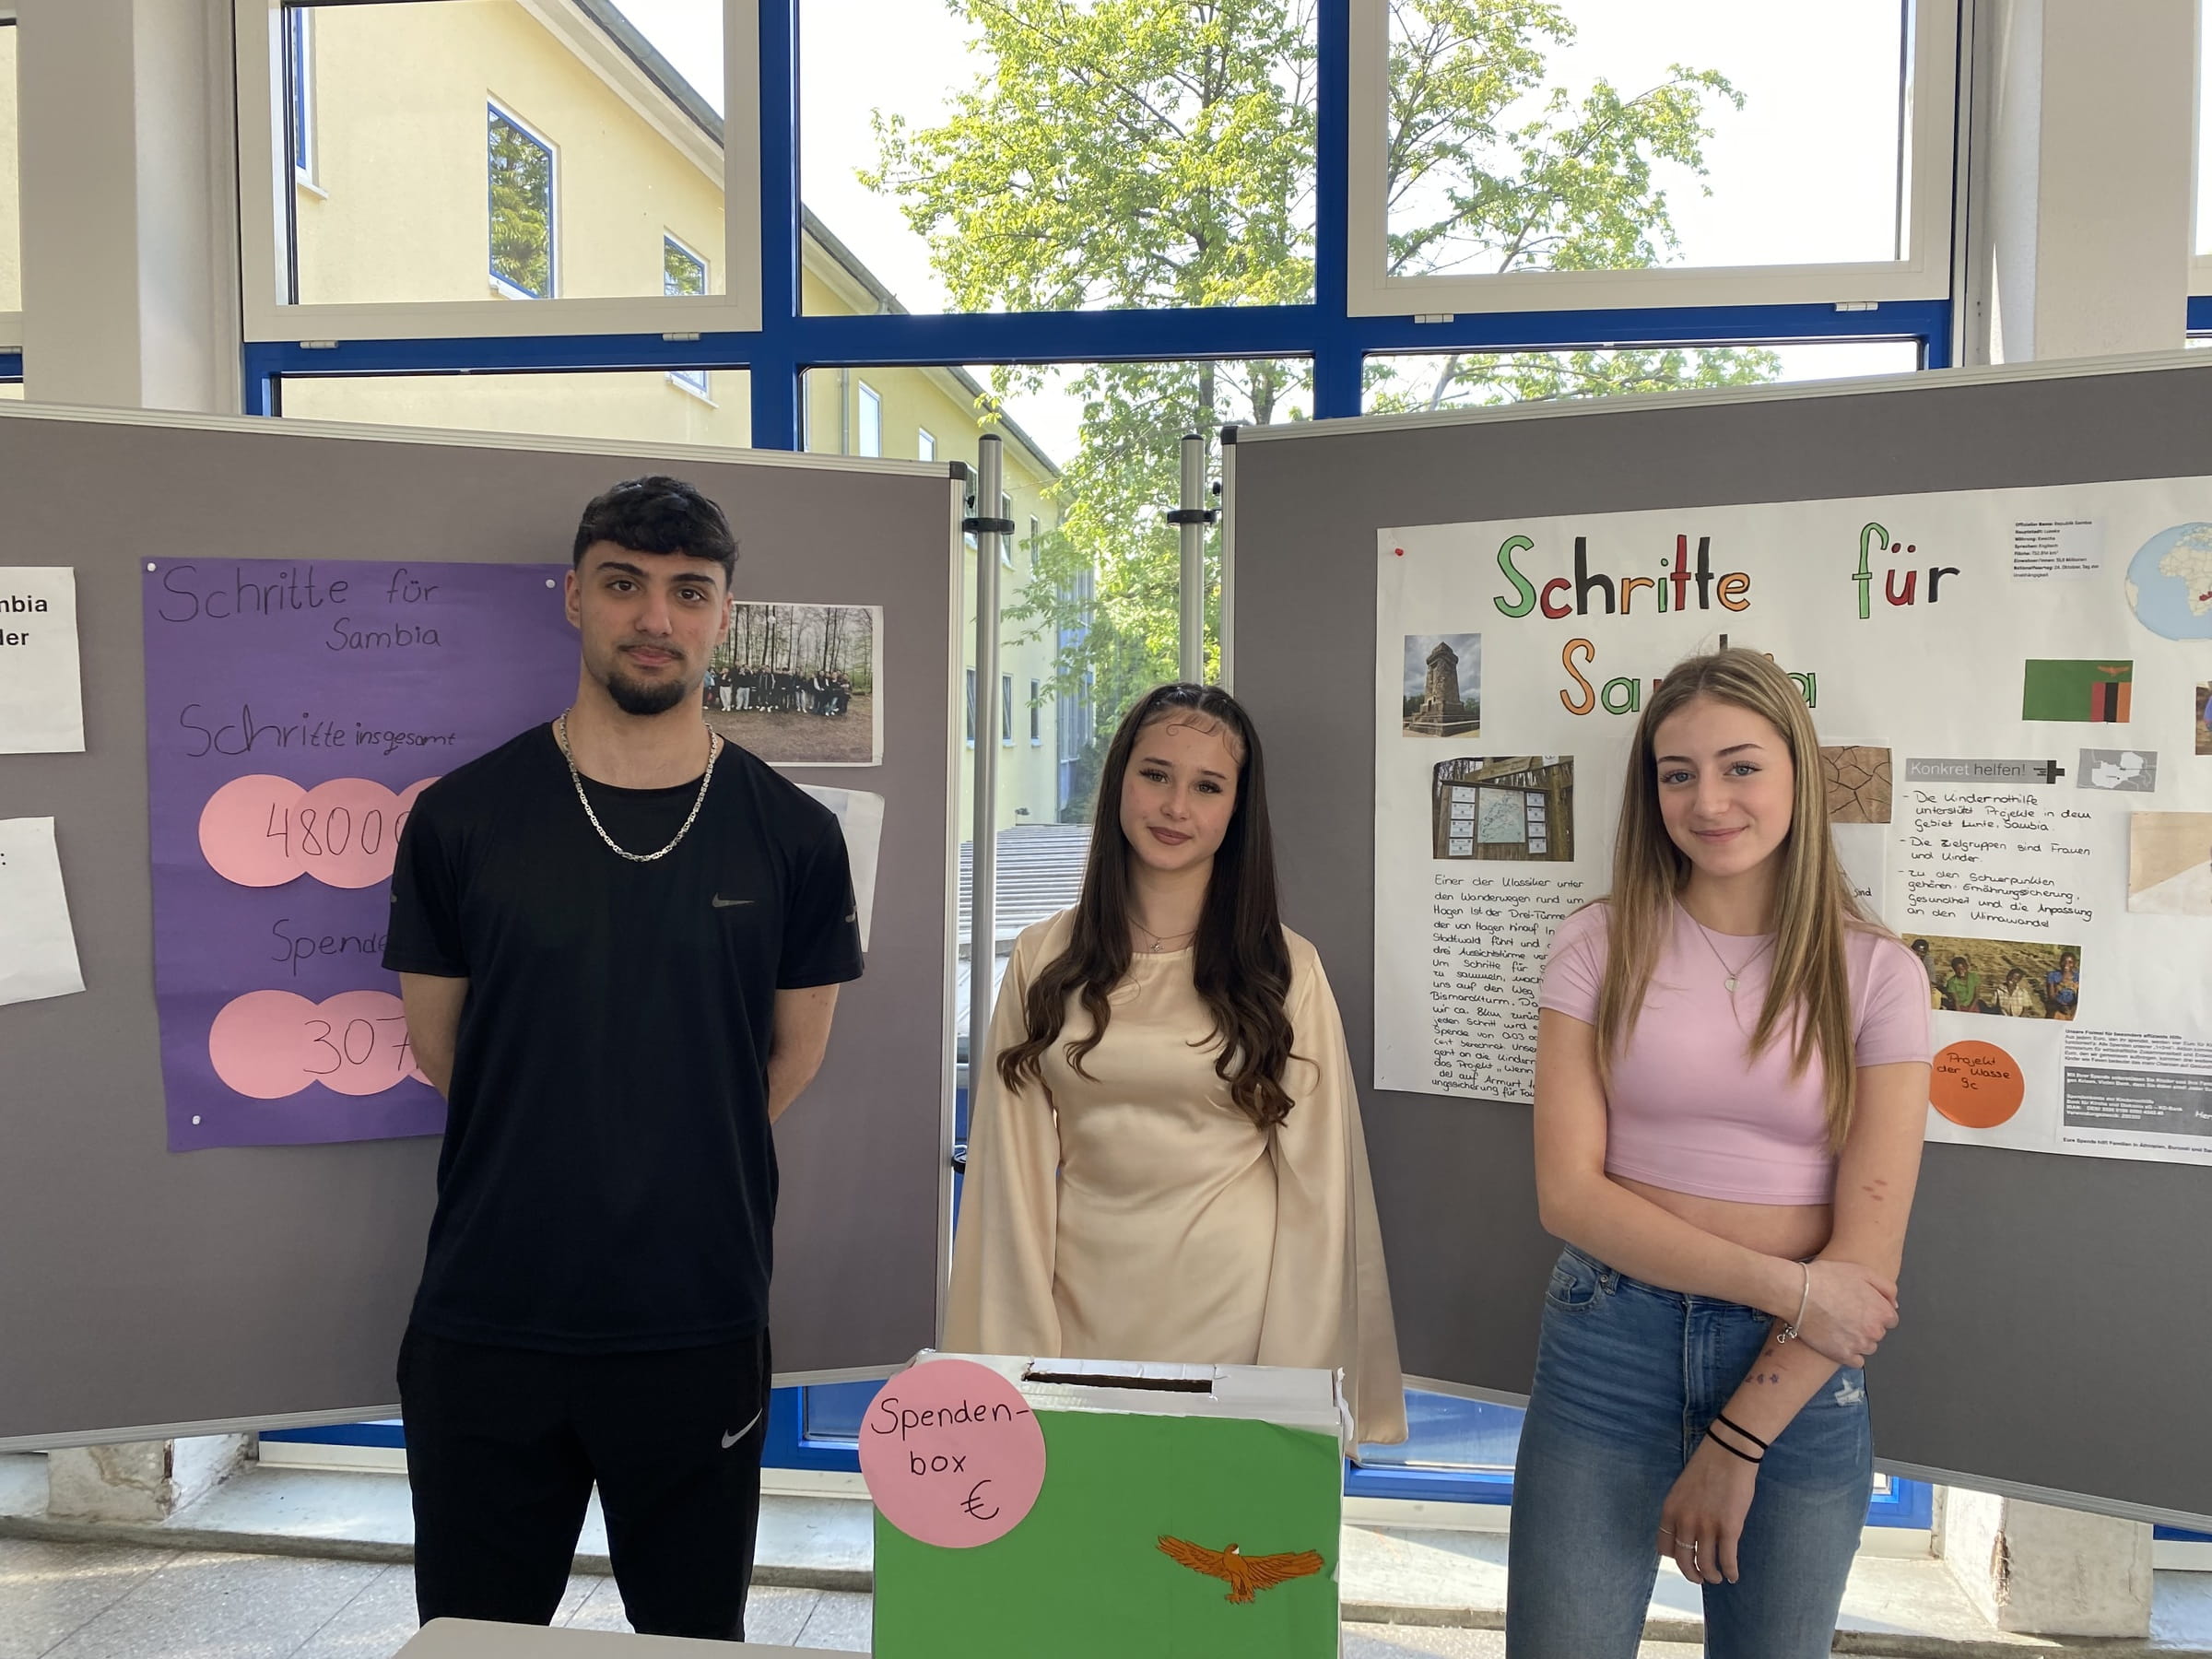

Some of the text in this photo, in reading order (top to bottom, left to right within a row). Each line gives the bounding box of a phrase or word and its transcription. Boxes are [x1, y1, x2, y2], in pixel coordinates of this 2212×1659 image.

[1493, 521, 1960, 619] Schritte für
[159, 565, 439, 623] Schritte für
[326, 617, 441, 651] Sambia
[180, 703, 456, 758] Schritte insgesamt
[1911, 761, 2026, 776] Konkret helfen!
[2043, 809, 2055, 818] in
[2061, 809, 2091, 818] dem
[1914, 818, 1953, 832] Gebiet
[1910, 836, 2091, 856] Die Zielgruppen sind Frauen
[1911, 852, 1934, 860] und
[1435, 874, 1584, 888] Einer der Klassiker unter
[1435, 891, 1454, 900] den
[1461, 892, 1531, 907] Wanderwegen
[1536, 895, 1559, 904] rund
[1434, 903, 1464, 919] Hagen
[1486, 907, 1502, 917] der
[1908, 892, 2093, 923] Gesundheit und die Anpassung
[1907, 908, 2050, 928] an den Klimawandel
[1434, 921, 1451, 929] der
[1455, 922, 1471, 930] von
[1476, 922, 1504, 935] Hagen
[1510, 923, 1539, 935] hinauf
[1433, 932, 1481, 945] Stadtwald
[1491, 935, 1513, 947] führt
[1521, 938, 1540, 948] und
[1433, 946, 1452, 956] drei
[1432, 959, 1450, 967] Um
[1464, 959, 1501, 971] Schritte
[1512, 960, 1528, 973] für
[1433, 970, 1445, 978] zu
[1433, 981, 1535, 999] uns auf den Weg
[1432, 1003, 1451, 1014] wir
[1453, 1006, 1469, 1015] ca.
[1433, 1017, 1460, 1029] jeden
[1466, 1018, 1496, 1028] Schritt
[1434, 1026, 1470, 1038] Spende
[1477, 1031, 1495, 1040] von
[1434, 1049, 1455, 1061] geht
[1476, 1053, 1491, 1061] die
[1947, 1052, 1996, 1068] Projekt
[1434, 1059, 1453, 1068] das
[1456, 1059, 1494, 1072] Projekt
[1936, 1065, 2011, 1079] der Klasse
[1439, 1070, 1453, 1078] del
[1459, 1072, 1479, 1086] auf
[1503, 1086, 1518, 1099] für
[870, 1396, 1030, 1442] Spenden-
[909, 1449, 967, 1477] box
[959, 1478, 1000, 1521] €
